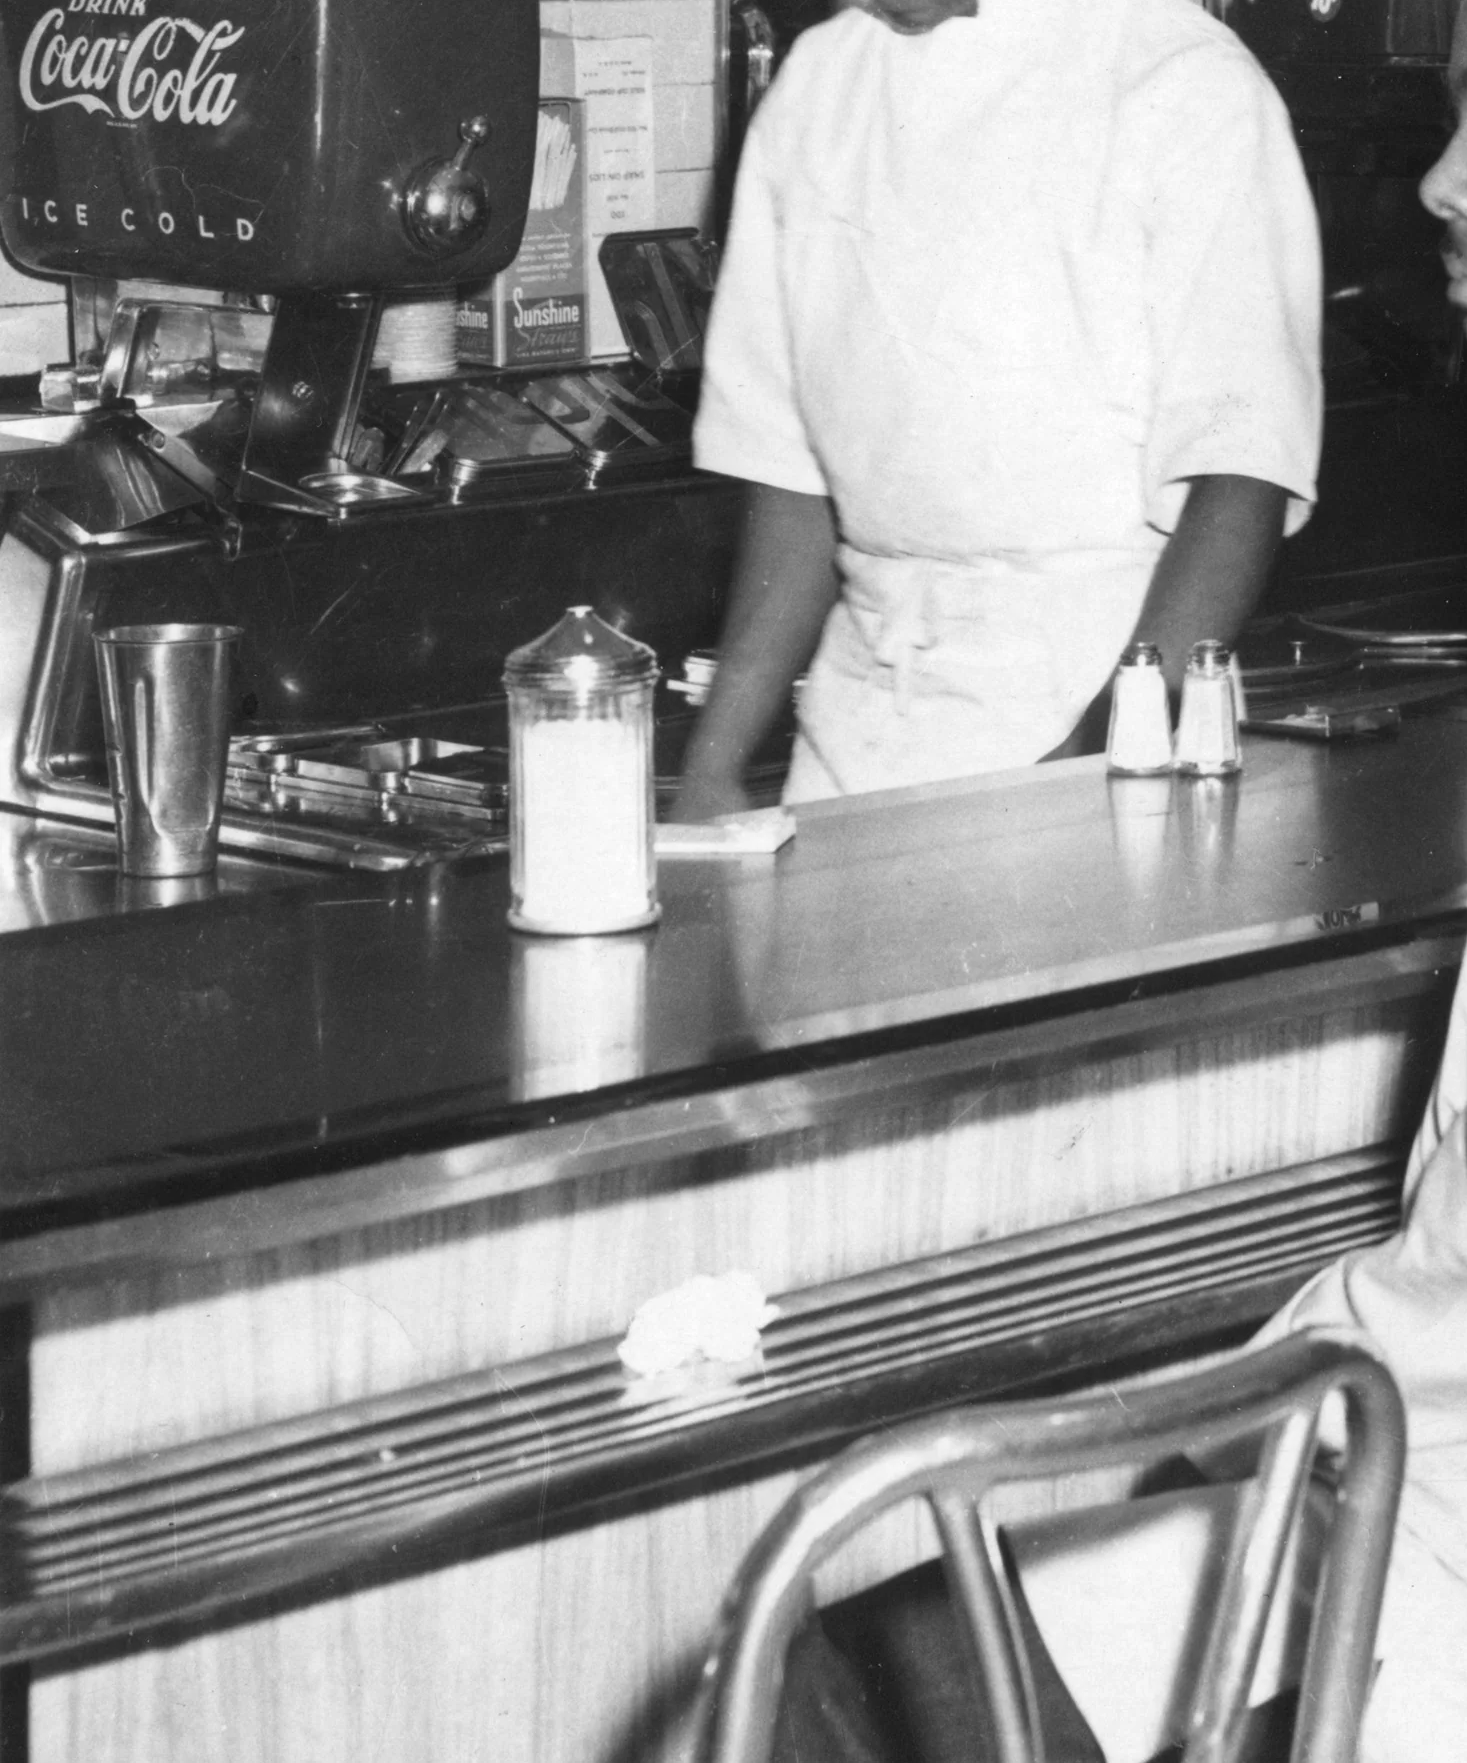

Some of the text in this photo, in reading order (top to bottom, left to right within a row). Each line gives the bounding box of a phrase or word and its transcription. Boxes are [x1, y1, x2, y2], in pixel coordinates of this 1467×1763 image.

[19, 7, 246, 126] Coca-Cola
[22, 196, 254, 242] ICE COLD
[513, 287, 580, 329] Sunshine
